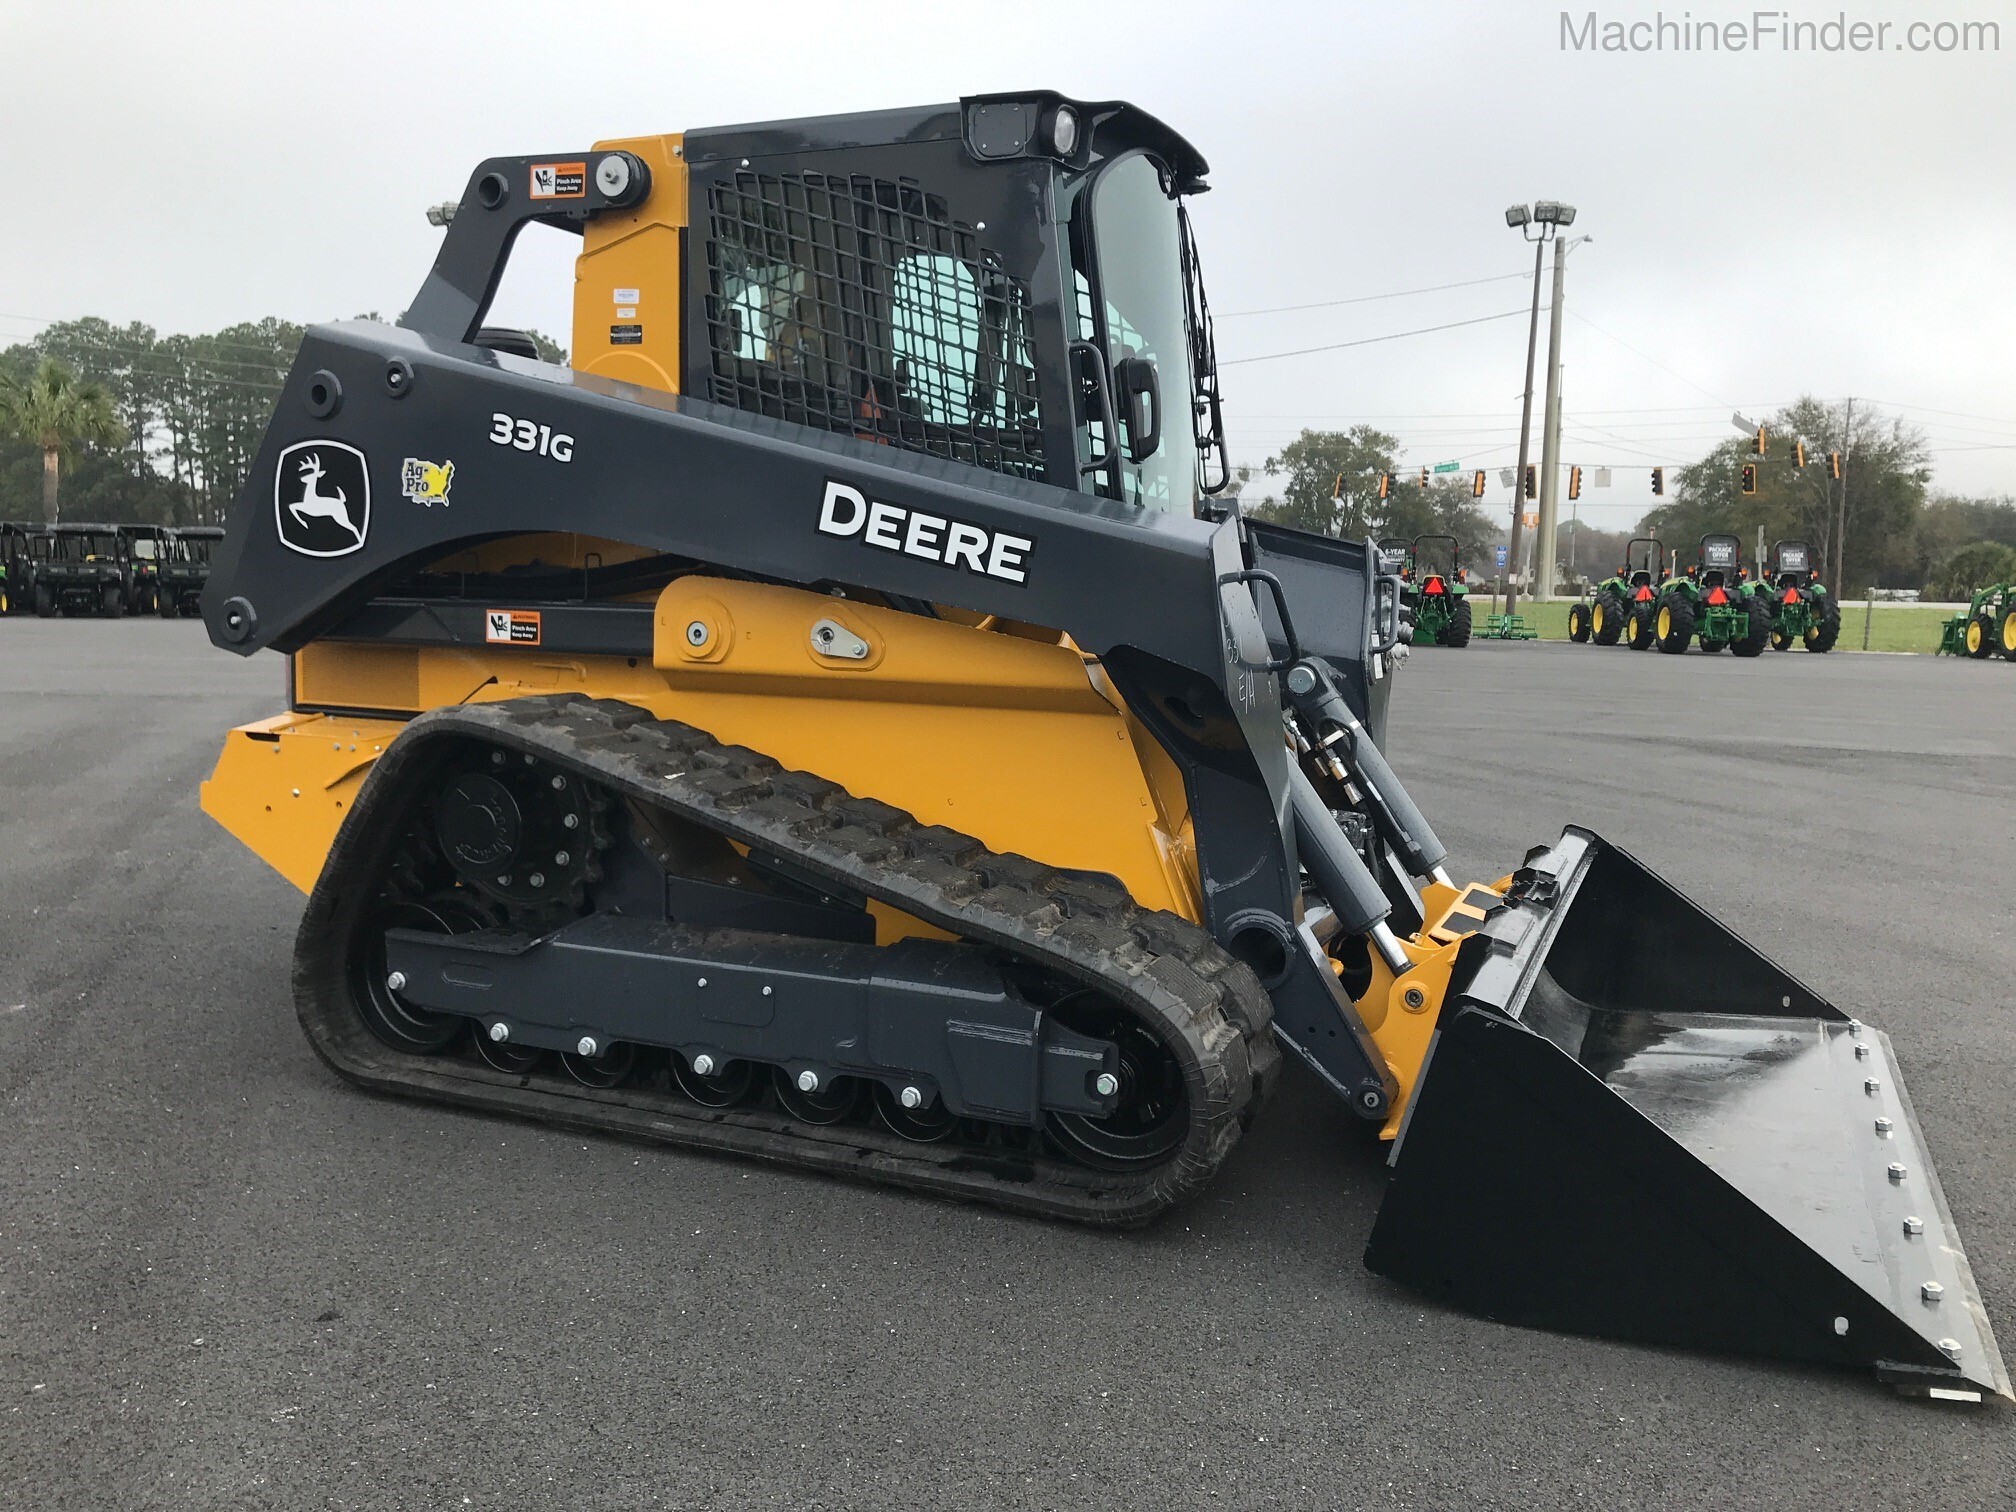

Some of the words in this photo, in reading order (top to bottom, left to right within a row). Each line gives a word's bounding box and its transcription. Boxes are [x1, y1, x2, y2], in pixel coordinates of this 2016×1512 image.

[489, 412, 575, 463] 331G
[405, 462, 429, 480] Ag-
[405, 477, 429, 492] Pro
[818, 480, 1032, 583] DEERE
[1708, 546, 1732, 554] PACKAGE
